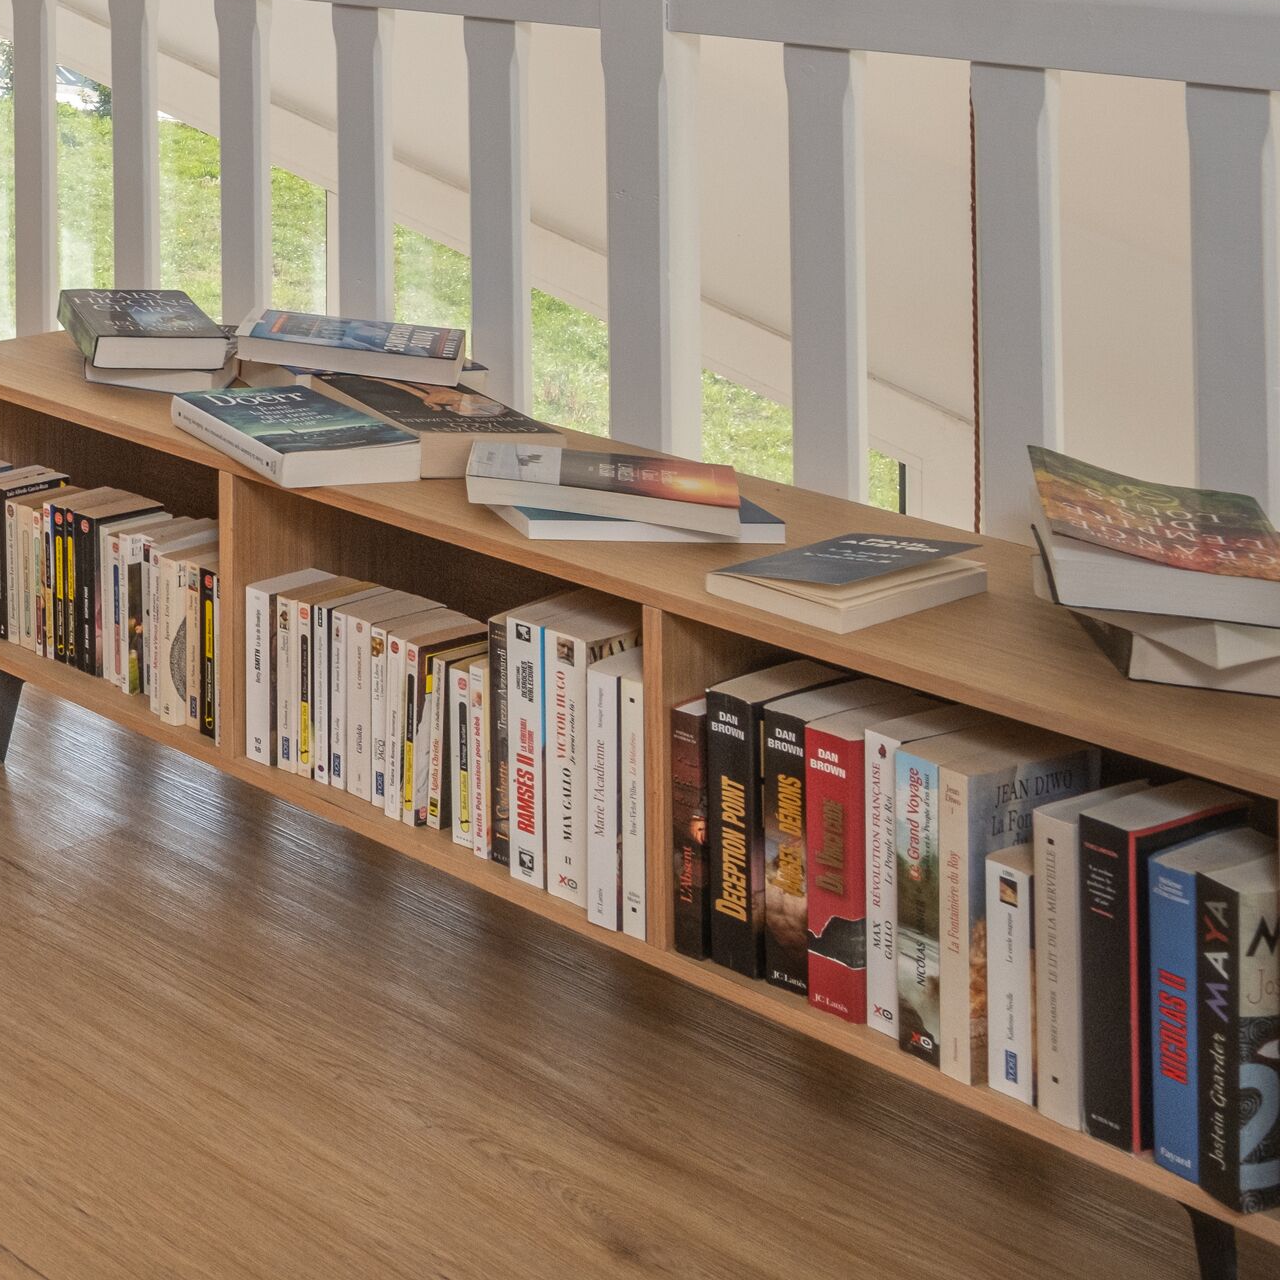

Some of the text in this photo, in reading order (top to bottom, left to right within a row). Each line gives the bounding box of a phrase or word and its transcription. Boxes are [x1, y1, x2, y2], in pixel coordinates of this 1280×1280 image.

[203, 392, 306, 406] Doerr
[1083, 487, 1221, 523] LOUPS
[1116, 508, 1197, 531] DES
[838, 540, 940, 553] AUSTER
[864, 538, 930, 547] PAUL
[527, 661, 535, 703] NOBLECOURT
[473, 716, 481, 737] bébé
[497, 700, 507, 730] Trezza
[556, 671, 566, 759] VICTOR HUGO
[719, 711, 738, 726] DAN
[711, 722, 744, 741] BROWN
[775, 728, 796, 742] DAN
[377, 740, 385, 762] JACQ
[475, 738, 483, 758] pour
[520, 745, 527, 753] LA
[767, 737, 803, 757] BROWN
[818, 749, 839, 763] DAN
[810, 759, 846, 779] BROWN
[497, 761, 508, 818] Cachette
[512, 754, 535, 835] RAMSÈS II
[594, 740, 605, 837] Marie l'Acadienne
[945, 784, 959, 796] Jean
[995, 779, 1029, 808] JEAN
[563, 767, 572, 842] MAX GALLO
[774, 774, 802, 838] DÉMONS
[475, 812, 483, 838] Petits
[870, 762, 883, 908] RÉVOLUTION FRANÇAISE
[907, 768, 922, 881] Le Grand Voyage
[992, 816, 1004, 836] La
[715, 776, 747, 921] DECEPTION POINT
[885, 796, 894, 884] Le Peuple et le Roi
[680, 846, 694, 903] L'Absent
[947, 850, 961, 954] La Fontainière du Roy
[1047, 850, 1058, 983] LE LIT DE LA MERVEILLE
[1007, 912, 1015, 937] magique
[885, 920, 893, 960] GALLO
[915, 942, 927, 986] NICOLAS
[1203, 901, 1229, 1023] MAYA
[1158, 968, 1188, 1085] NICOLAS II
[1209, 1033, 1227, 1171] Jostein Gaarder
[1160, 1147, 1191, 1168] Fayard
